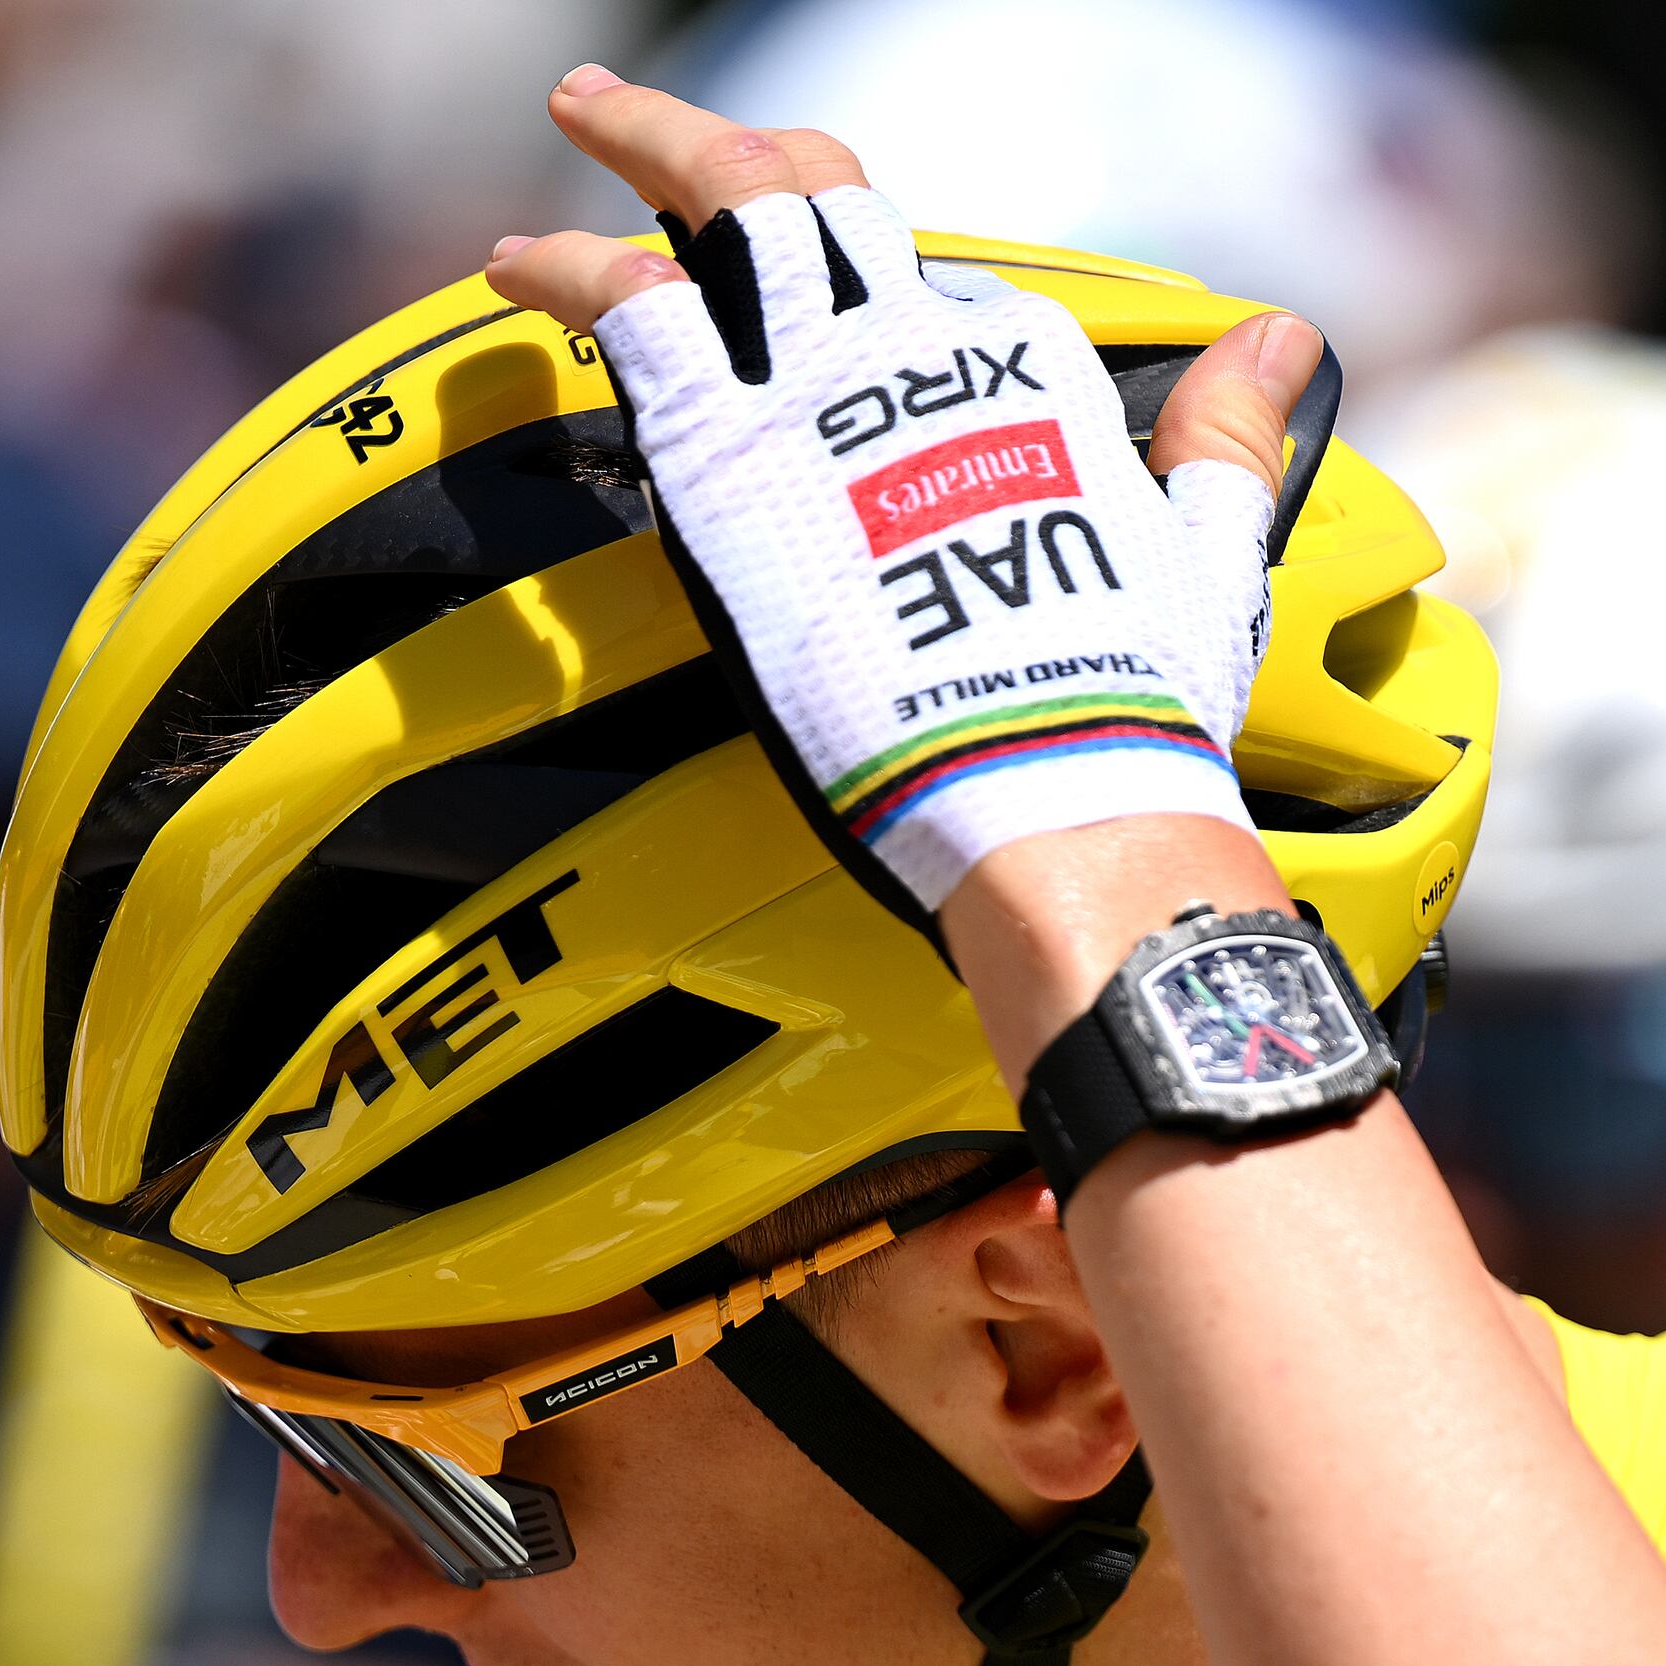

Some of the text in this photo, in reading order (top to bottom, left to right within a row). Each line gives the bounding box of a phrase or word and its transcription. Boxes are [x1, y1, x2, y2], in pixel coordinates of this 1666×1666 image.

[816, 341, 1046, 457] XRG
[876, 443, 1060, 523] Emirates
[879, 510, 1123, 652] UAE
[894, 669, 1016, 723] MILLE
[1421, 866, 1455, 917] Mips
[245, 868, 582, 1195] MET
[545, 1354, 659, 1407] SCICON
